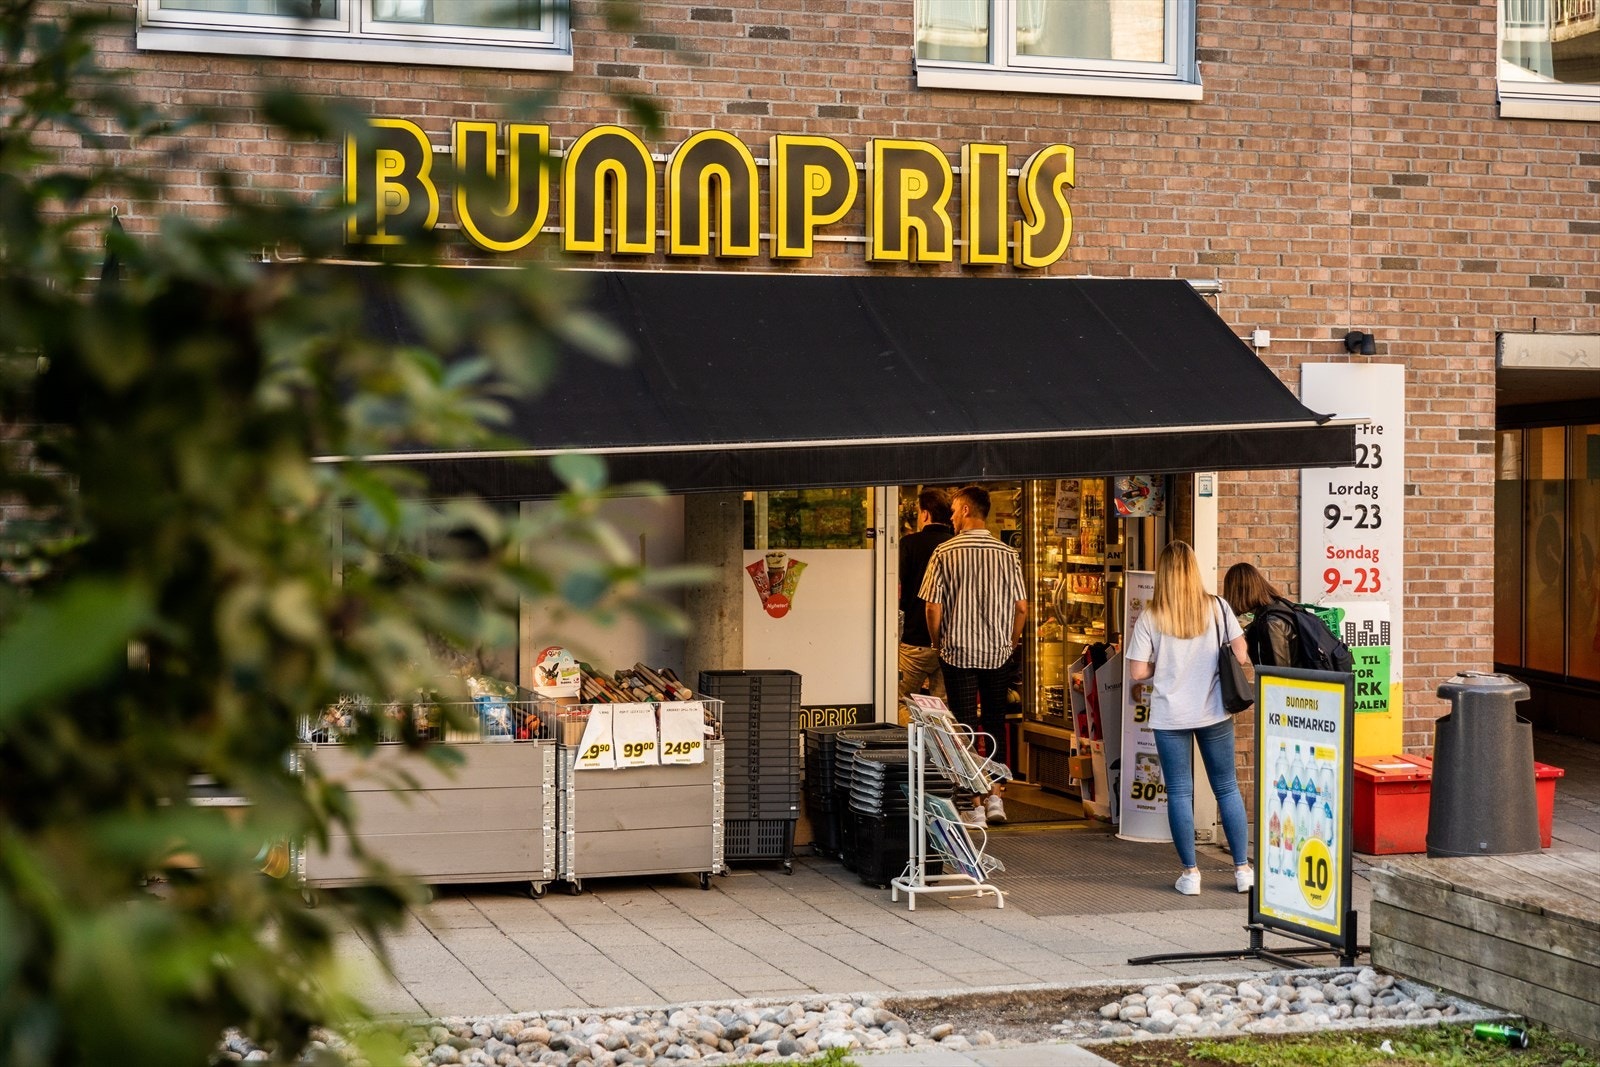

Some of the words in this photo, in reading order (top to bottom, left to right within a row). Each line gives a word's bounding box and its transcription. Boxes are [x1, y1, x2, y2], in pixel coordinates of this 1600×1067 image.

[343, 117, 1076, 270] BUNNPRIS
[1355, 424, 1384, 435] -Fre
[1355, 443, 1383, 469] 23
[1328, 481, 1379, 500] Lørdag
[1323, 503, 1382, 530] 9-23
[1326, 545, 1380, 563] Søndag
[1323, 567, 1382, 594] 9-23
[1361, 655, 1381, 665] TIL
[1357, 681, 1383, 697] RK
[1285, 696, 1319, 711] BUNNPRIS
[1353, 699, 1387, 710] DALEN
[800, 707, 857, 730] NPRIS
[1304, 855, 1328, 891] 10
